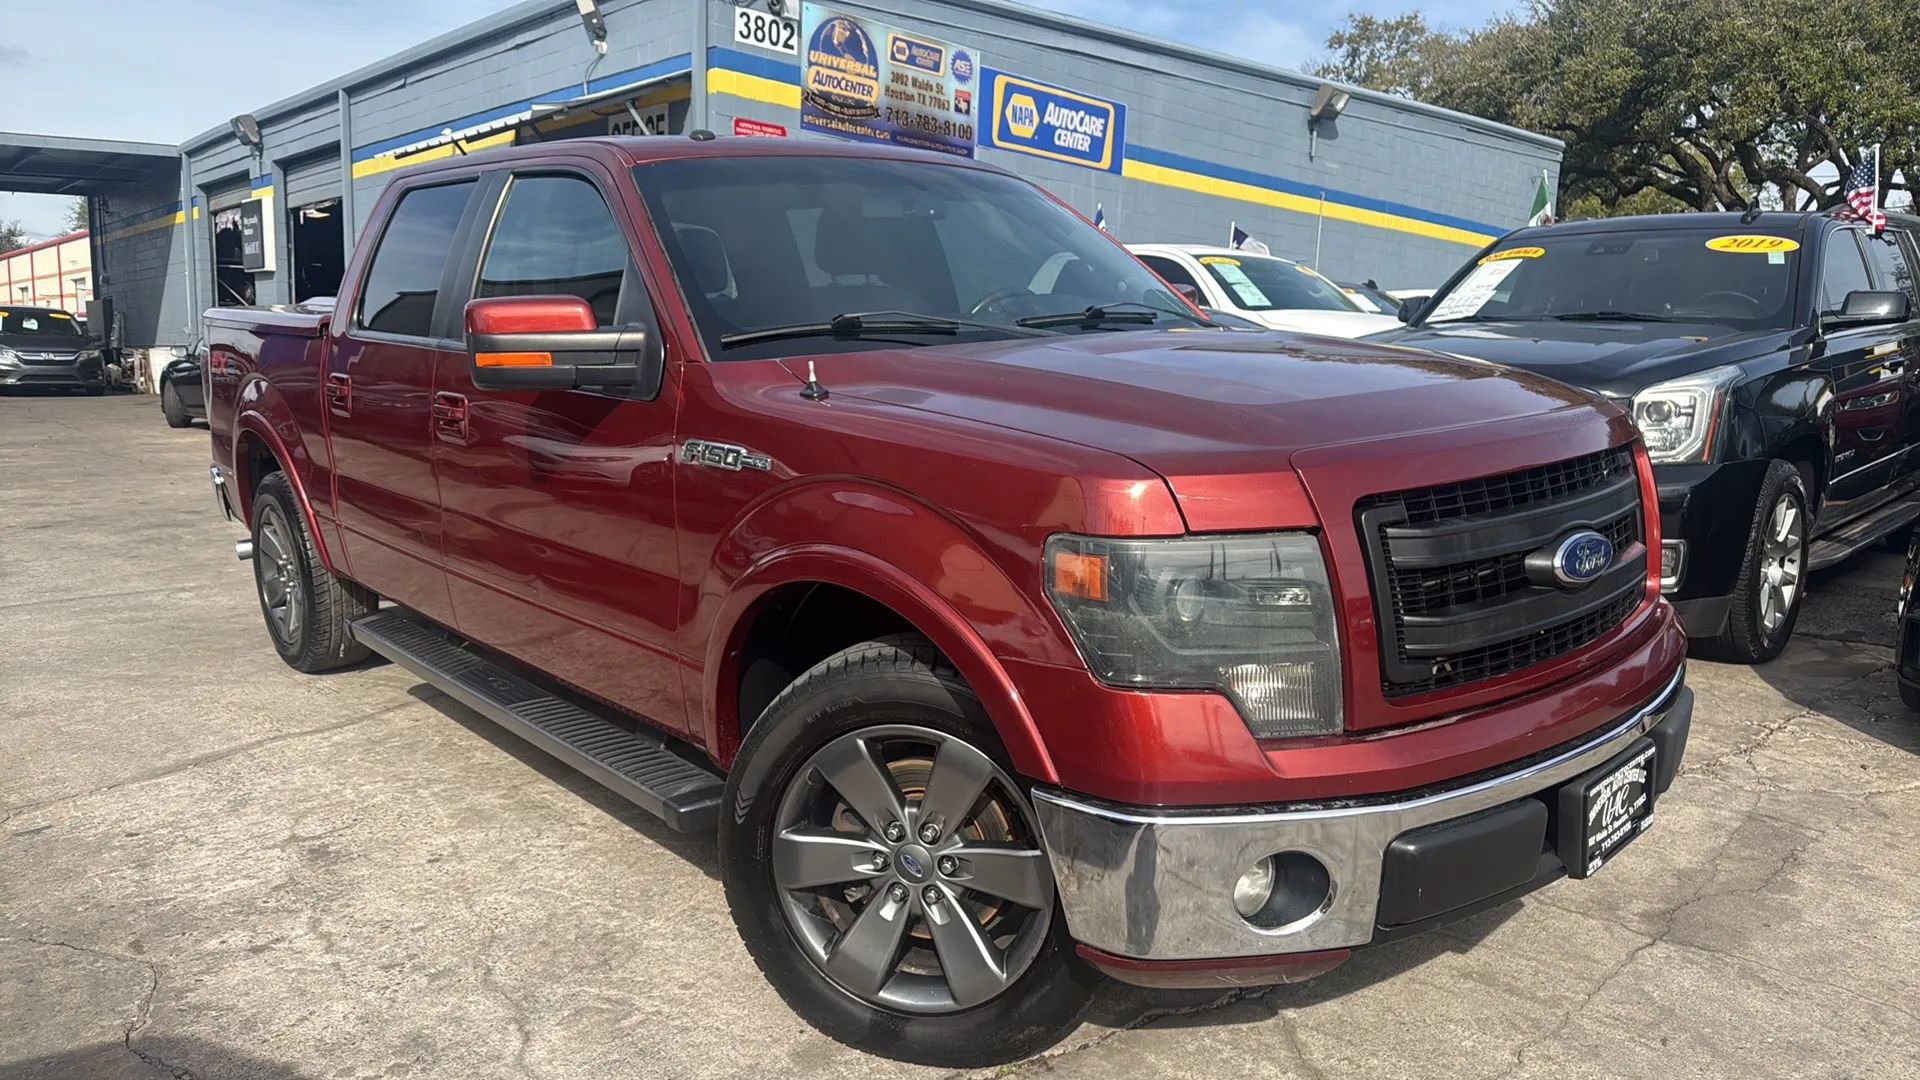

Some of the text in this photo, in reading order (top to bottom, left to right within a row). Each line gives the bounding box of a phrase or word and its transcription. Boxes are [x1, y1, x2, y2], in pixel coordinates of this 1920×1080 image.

[738, 11, 796, 51] 3802
[809, 49, 877, 78] UNIVERSAL
[884, 86, 916, 104] Houston
[917, 92, 927, 106] TX
[1011, 106, 1036, 129] NAPA
[1053, 126, 1091, 153] CENTER
[1727, 236, 1783, 252] 2019
[1575, 542, 1607, 575] Ford
